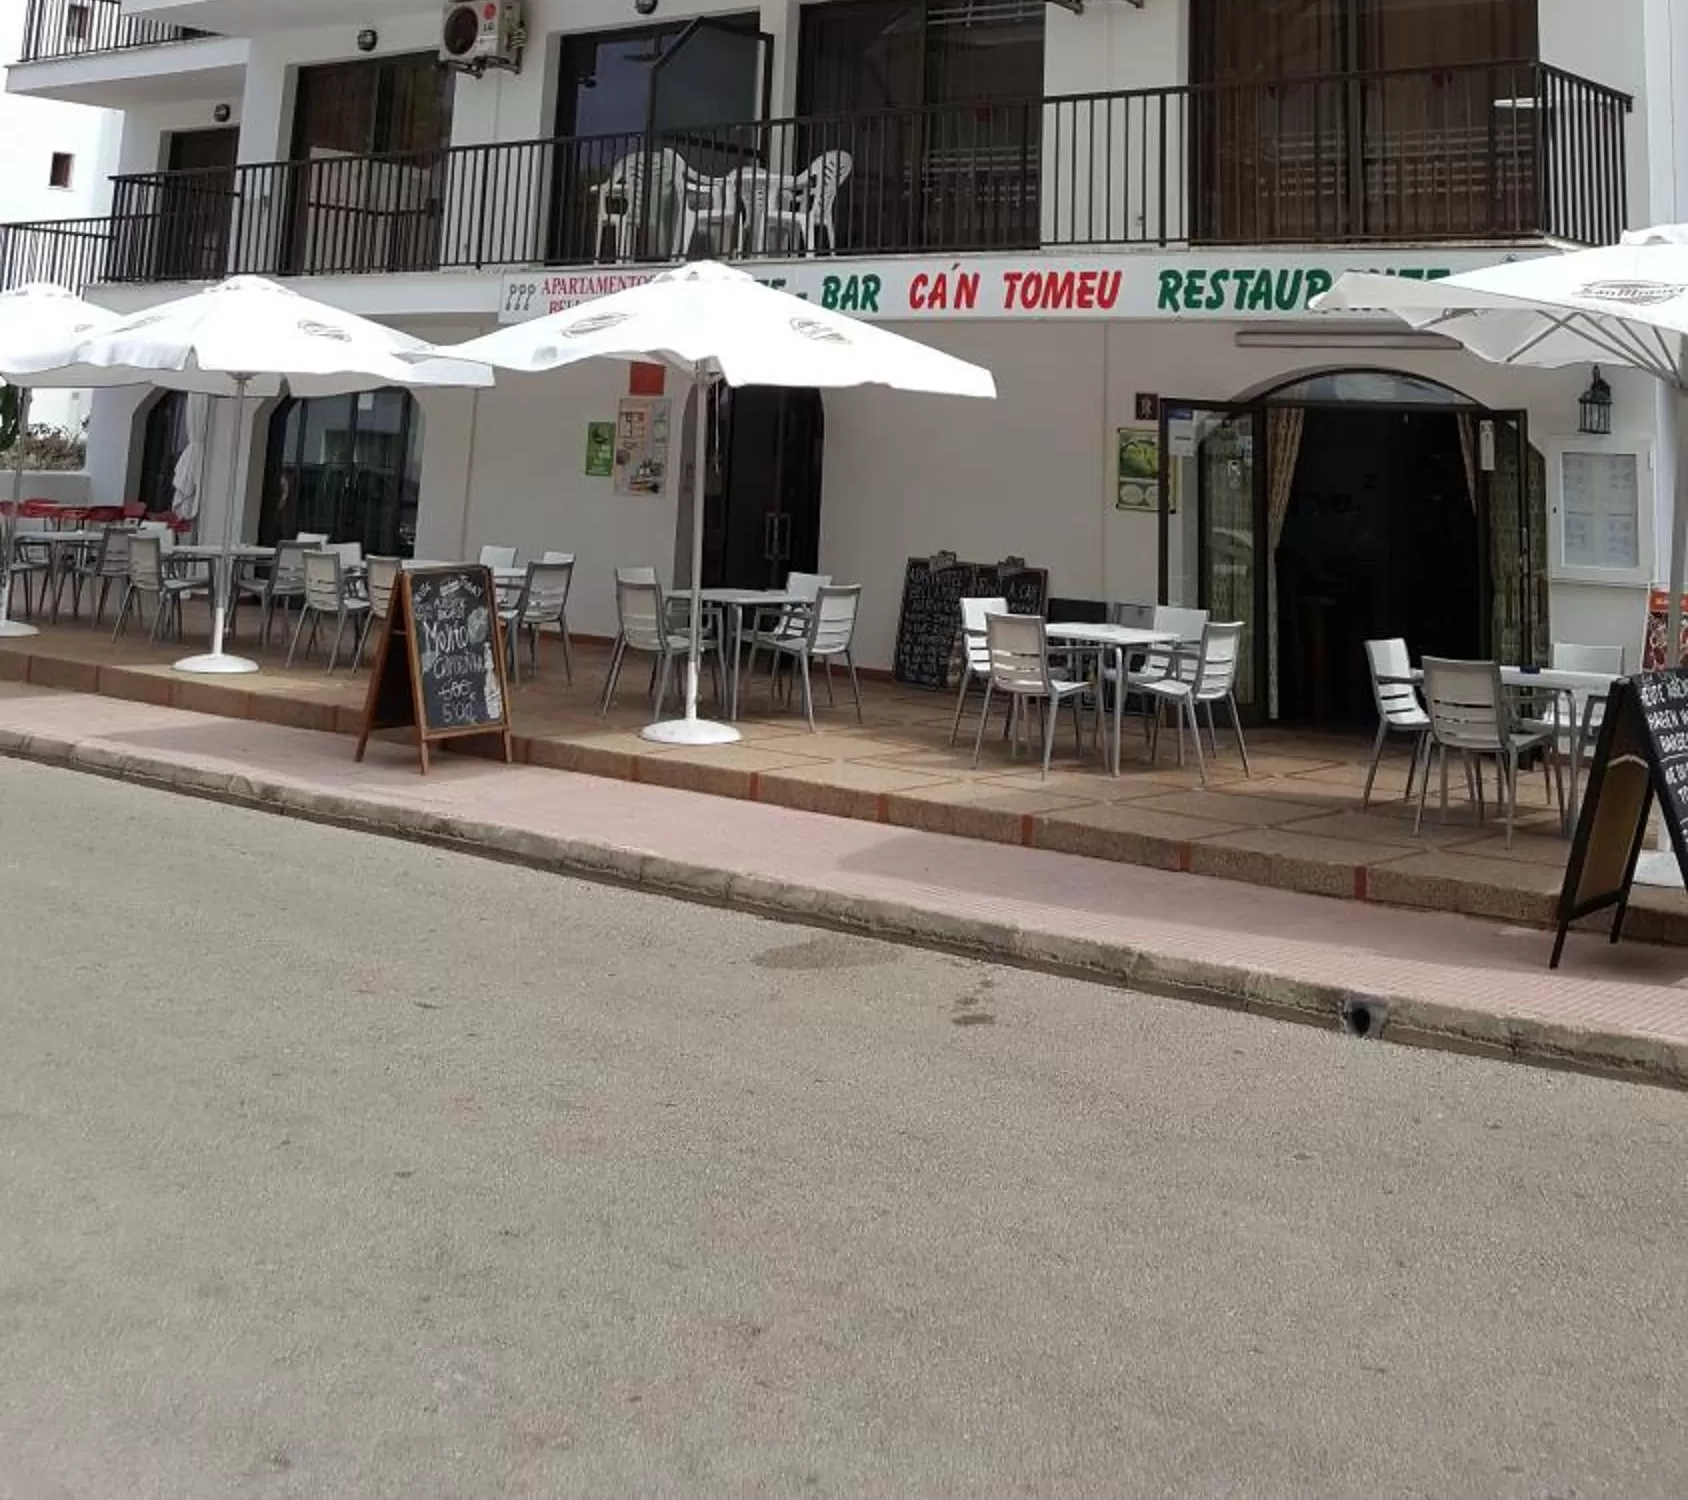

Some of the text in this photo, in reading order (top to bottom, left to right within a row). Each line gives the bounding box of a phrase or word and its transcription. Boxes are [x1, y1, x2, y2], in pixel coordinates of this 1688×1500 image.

[541, 275, 657, 296] APARTAMENTO
[821, 273, 882, 313] BAR
[1003, 270, 1122, 310] TOMEU
[1157, 267, 1451, 314] RESTAUR
